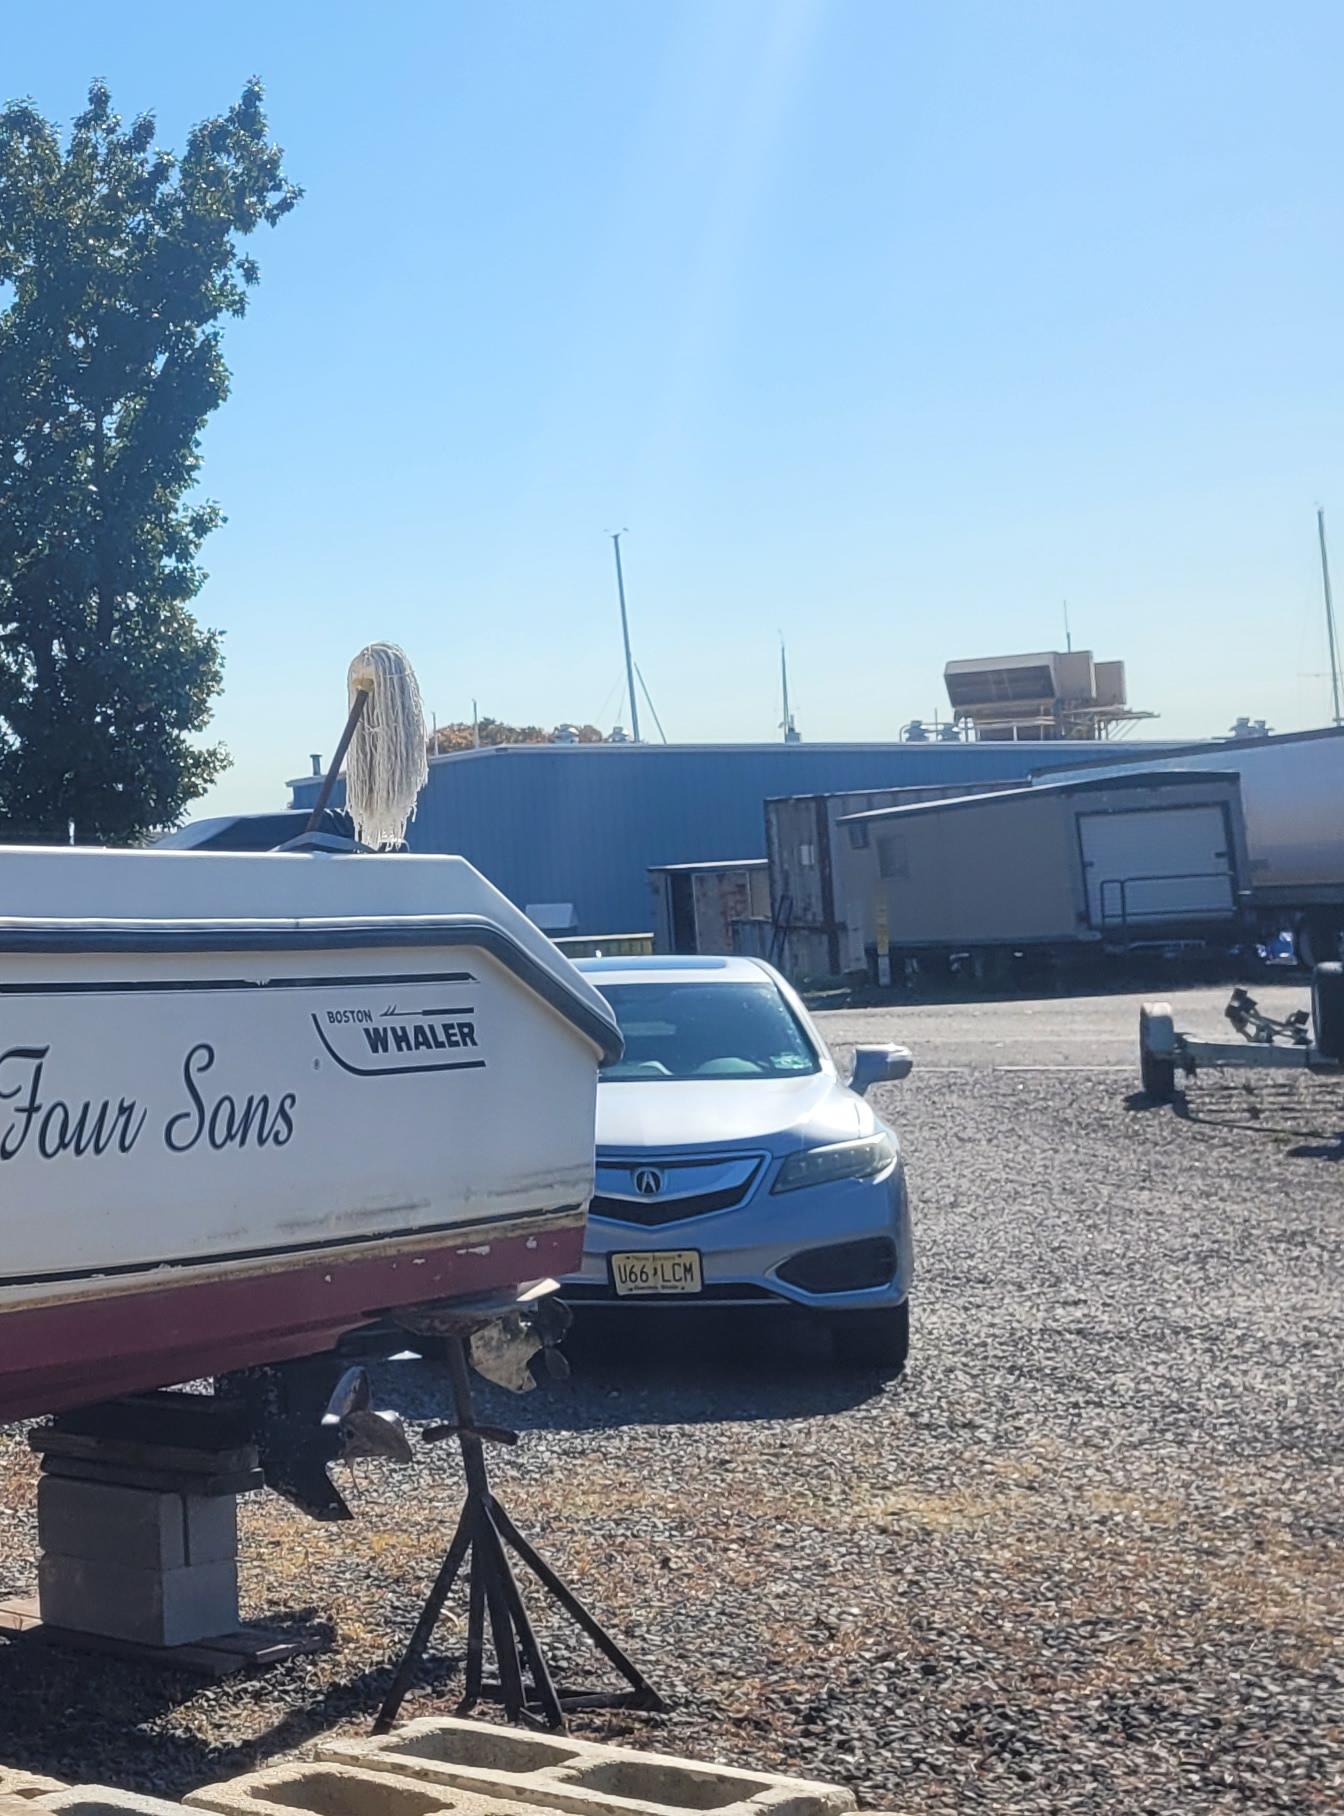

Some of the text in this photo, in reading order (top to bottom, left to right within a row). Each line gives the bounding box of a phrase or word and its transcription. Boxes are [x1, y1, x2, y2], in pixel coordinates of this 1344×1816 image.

[326, 1009, 373, 1024] BOSTON
[362, 1021, 479, 1054] WHALER
[163, 1043, 298, 1152] Sons
